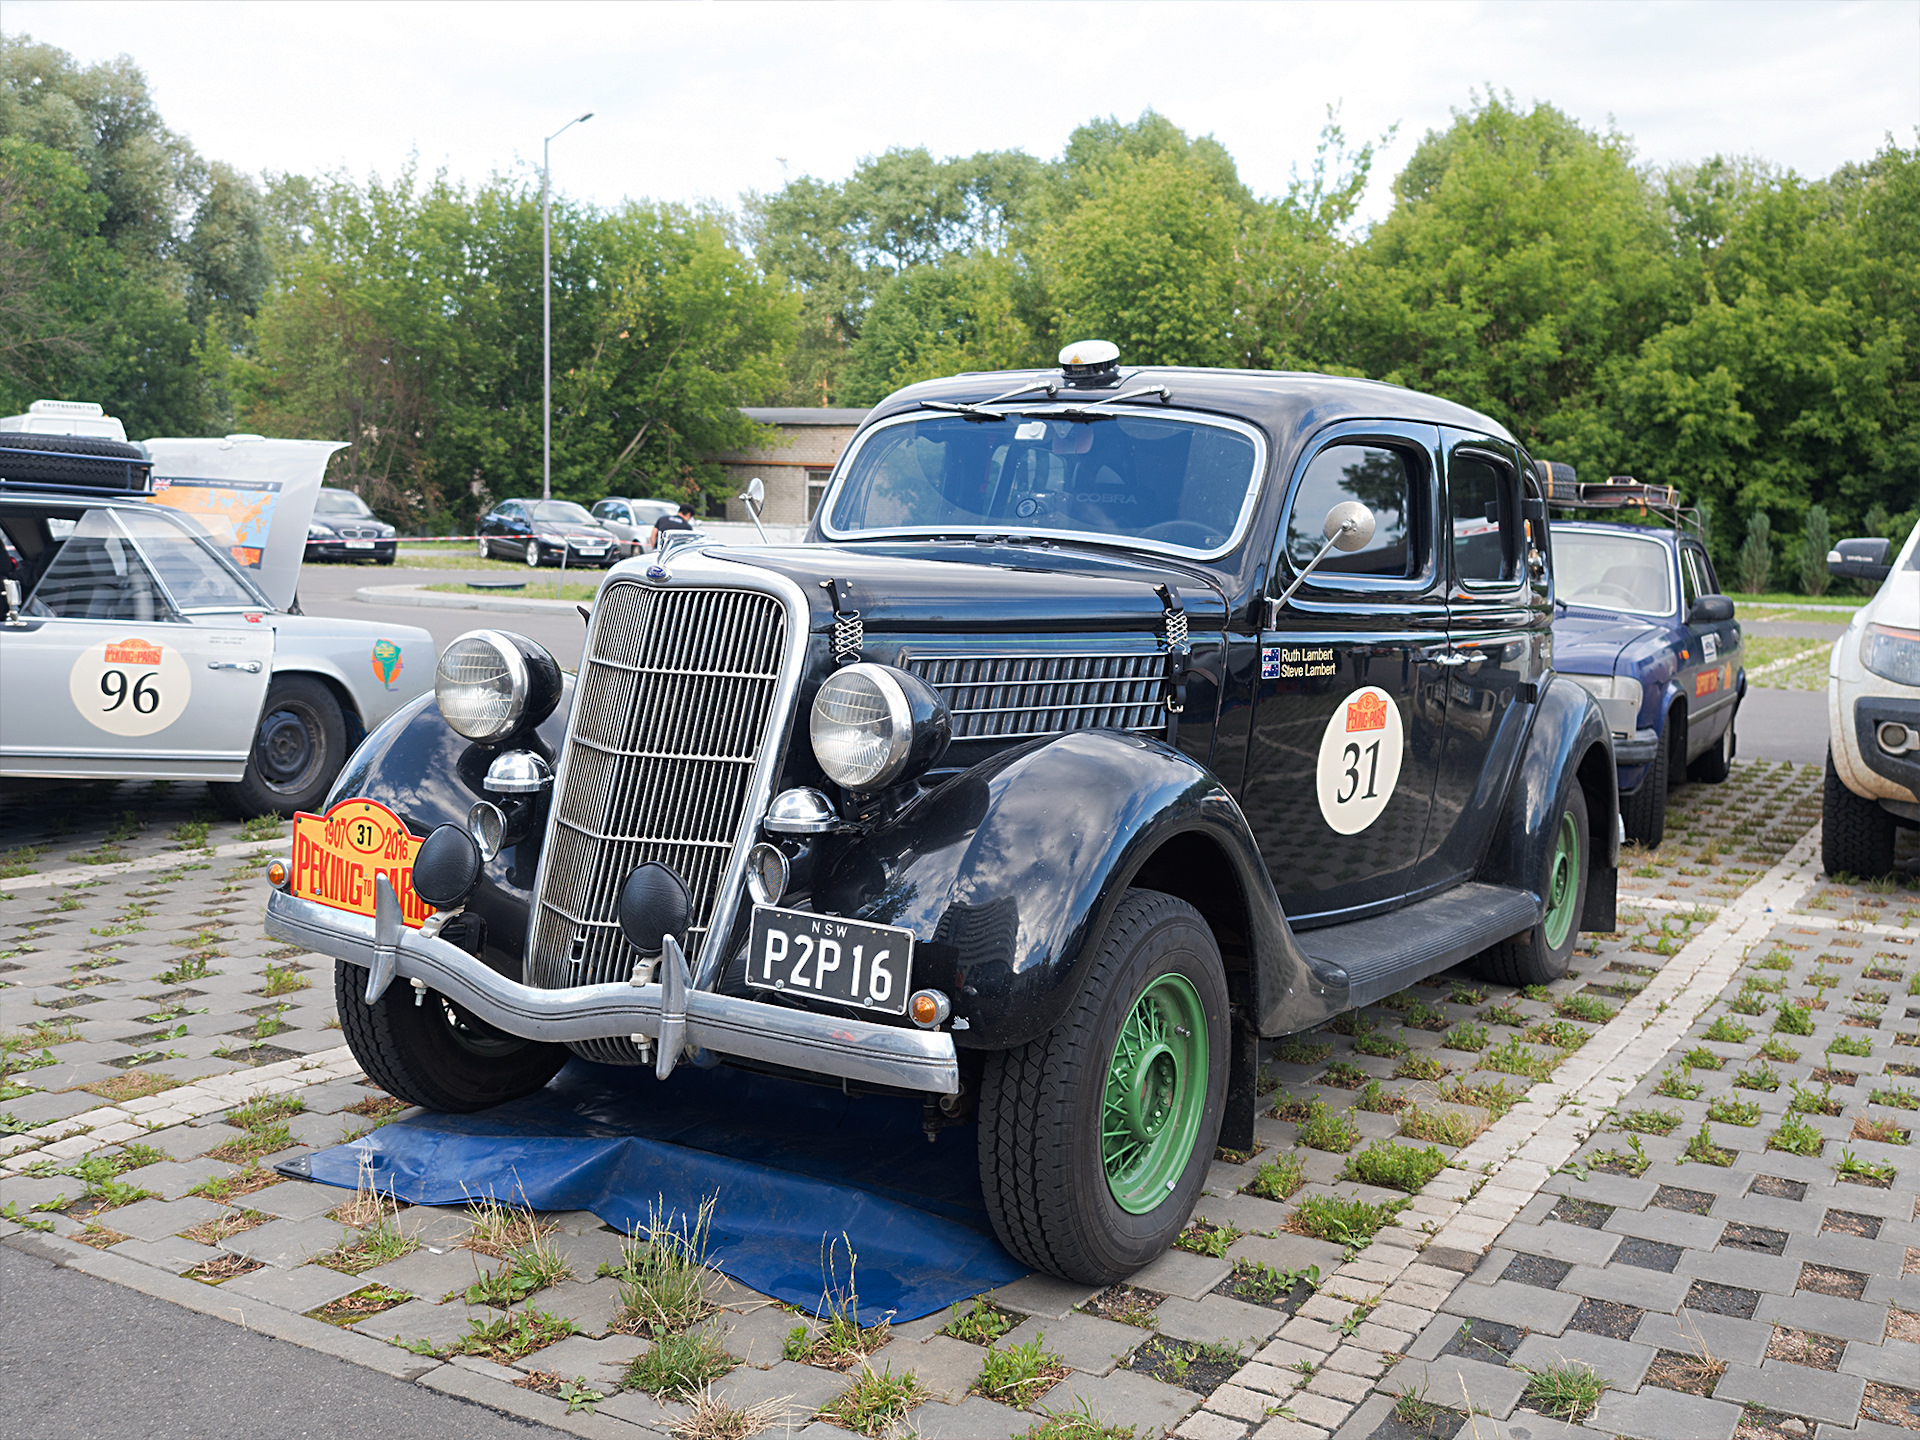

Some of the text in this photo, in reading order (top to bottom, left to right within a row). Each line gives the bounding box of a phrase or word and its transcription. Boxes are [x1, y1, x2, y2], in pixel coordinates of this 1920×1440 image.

[1075, 492, 1138, 505] COBRA
[105, 648, 161, 664] PEKING PARIS
[1281, 647, 1334, 662] Ruth Lambert
[1281, 662, 1337, 678] Steve Lambert
[101, 669, 160, 714] 96
[1347, 704, 1387, 730] PEKING PARIS
[1337, 738, 1380, 804] 31
[324, 817, 409, 861] 1907 31 2016
[296, 831, 364, 907] PEKING
[363, 878, 372, 897] TO
[811, 920, 848, 939] NSW
[762, 928, 893, 1002] P2P16
